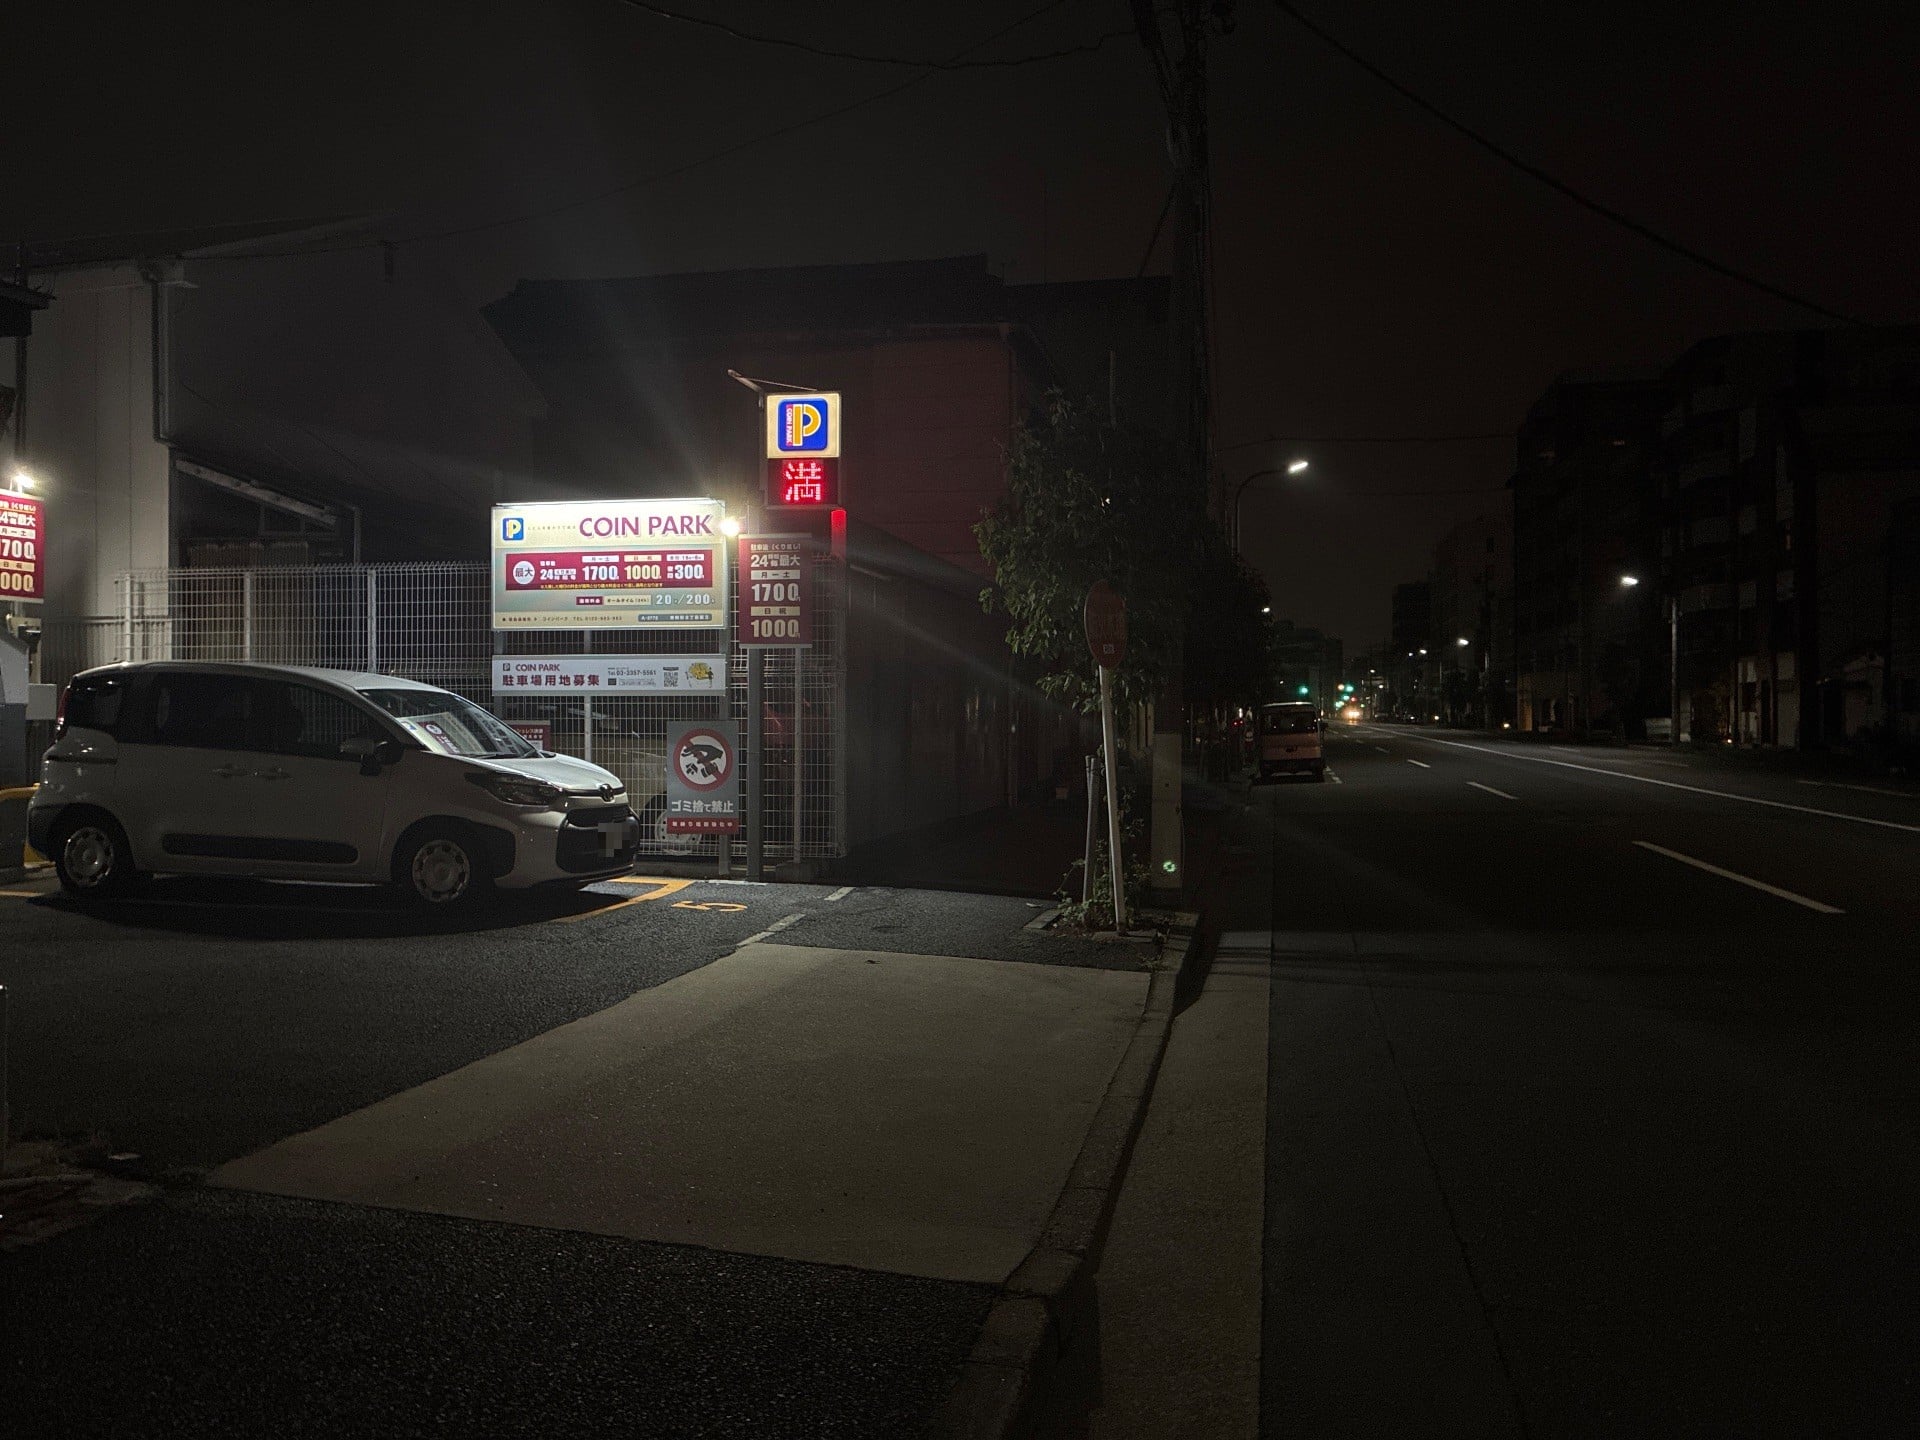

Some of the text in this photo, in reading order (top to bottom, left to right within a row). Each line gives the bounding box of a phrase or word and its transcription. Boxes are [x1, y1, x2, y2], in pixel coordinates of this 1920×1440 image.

[785, 462, 822, 501] 満
[579, 514, 712, 537] COIN PARK
[515, 567, 534, 578] 最大
[538, 663, 560, 671] PARK
[502, 674, 600, 686] 駐車場用地募集
[671, 799, 734, 813] ゴミ捨て禁止
